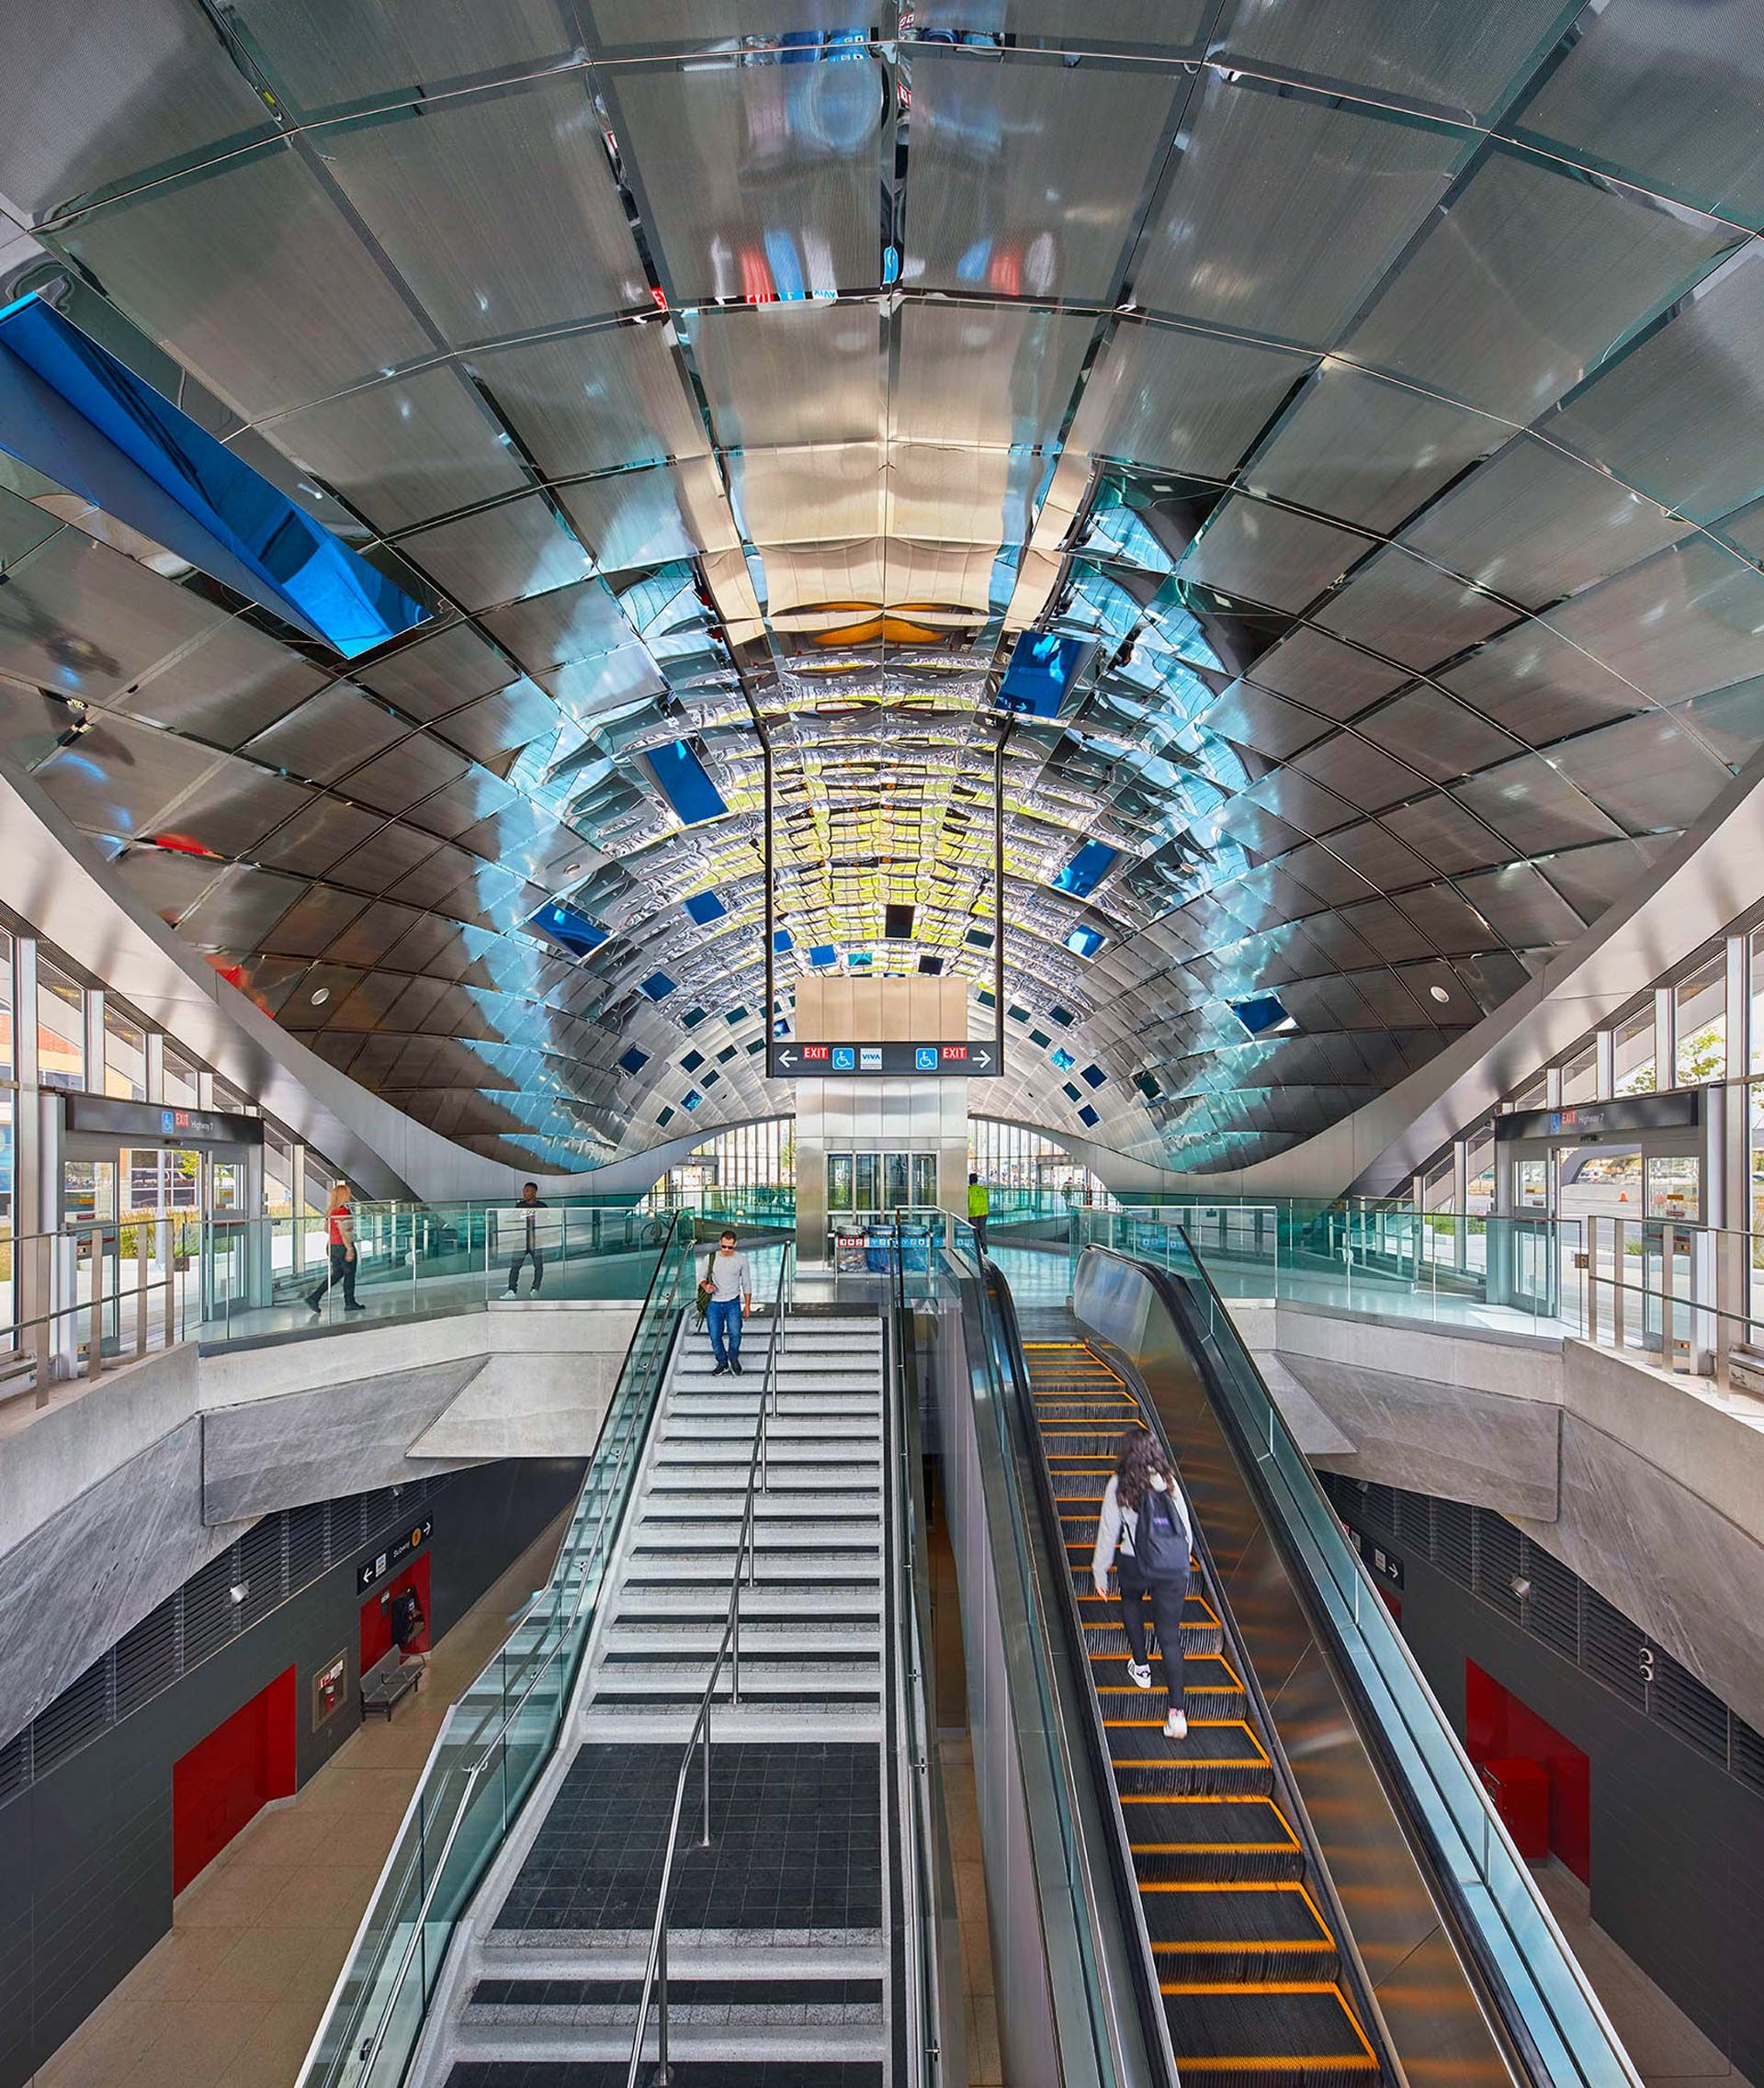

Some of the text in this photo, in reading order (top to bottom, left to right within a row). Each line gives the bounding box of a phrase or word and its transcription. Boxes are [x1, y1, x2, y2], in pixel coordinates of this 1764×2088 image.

[804, 1047, 828, 1058] EXIT
[943, 1047, 967, 1058] EXIT
[175, 1112, 189, 1126] EXIT
[1562, 1111, 1577, 1124] EXIT
[393, 1541, 411, 1558] Subway
